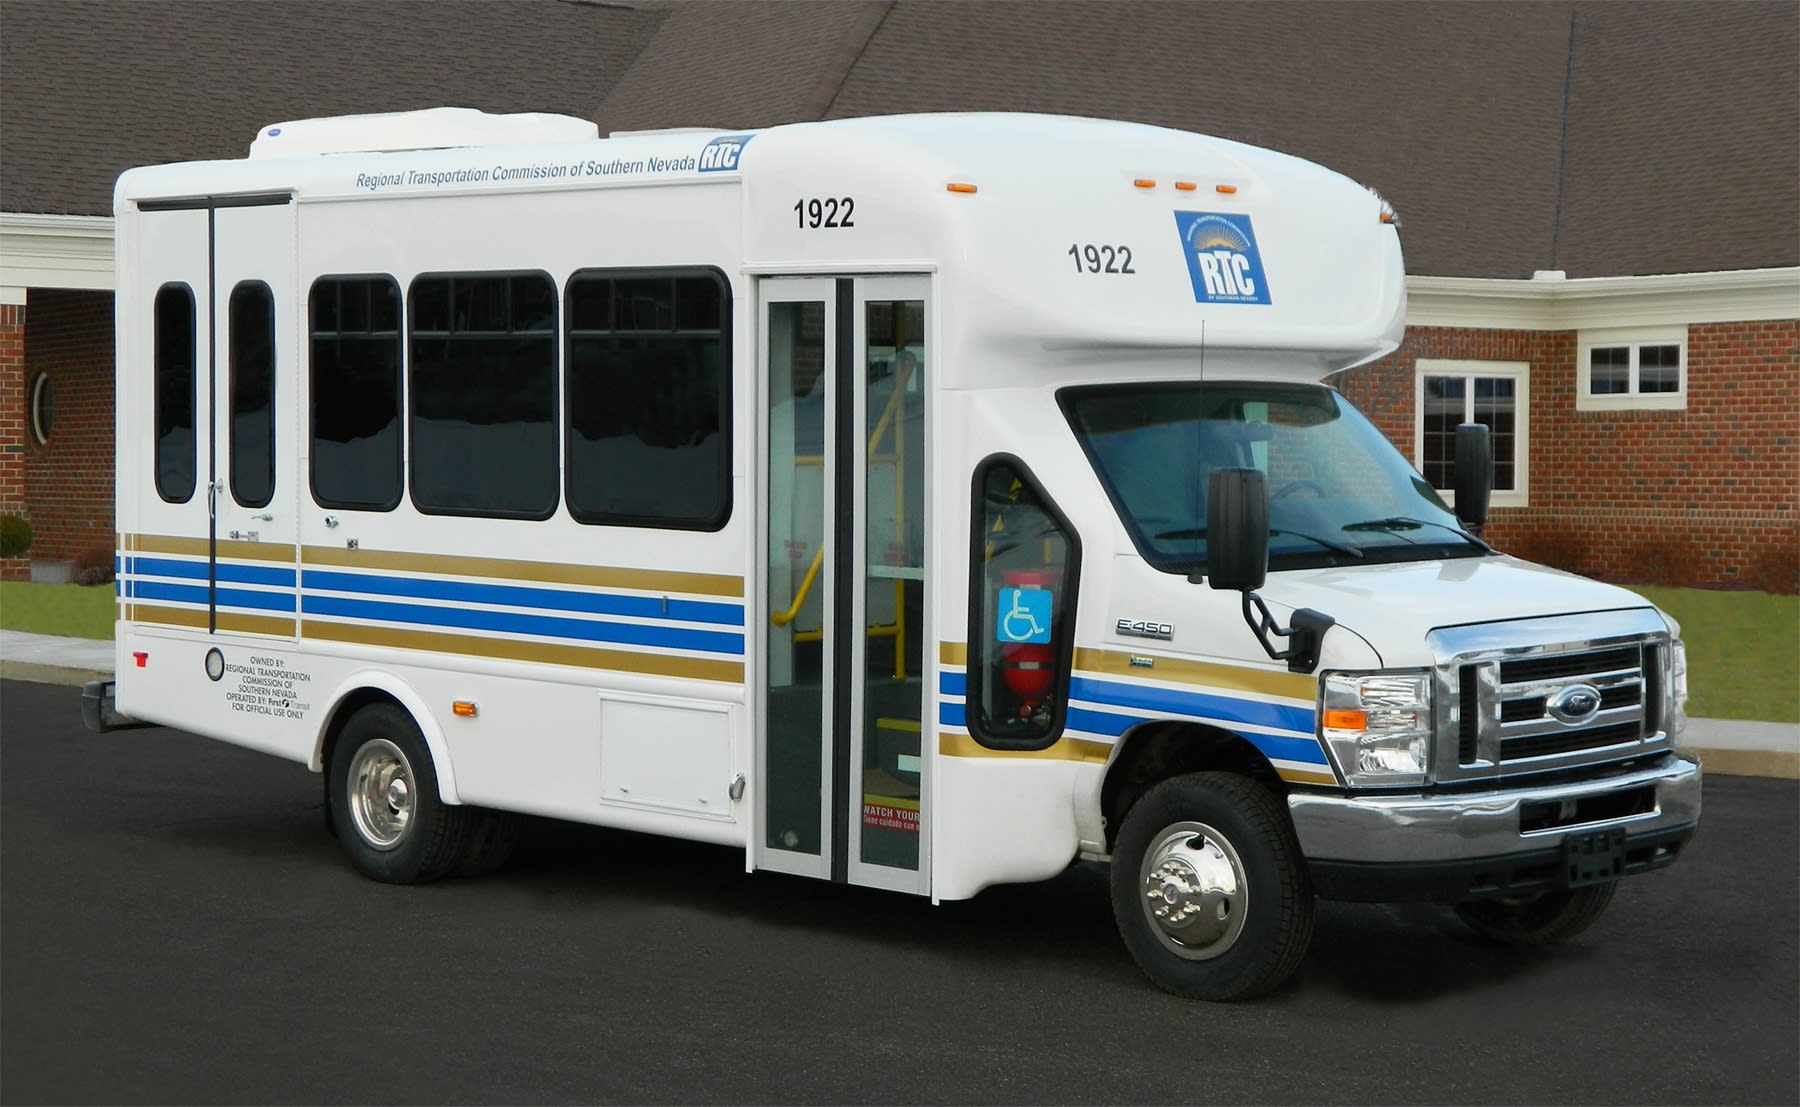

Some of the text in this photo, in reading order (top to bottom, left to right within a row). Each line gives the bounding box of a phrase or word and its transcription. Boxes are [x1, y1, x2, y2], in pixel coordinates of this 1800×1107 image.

[700, 143, 741, 169] RTC
[356, 155, 695, 191] Regional Transportation Commission of Southern Nevada
[794, 197, 854, 228] 1922
[1068, 243, 1136, 274] 1922
[1198, 250, 1255, 296] RTC
[250, 656, 285, 668] OWNED BY:
[226, 664, 311, 682] REGIONAL TRANSPORTATION
[242, 675, 293, 689] COMMISSION OF
[238, 684, 297, 699] SOUTHERN NEVADA
[226, 692, 310, 710] OPERATED BY: First Transit
[232, 702, 304, 719] FOR OFFICIAL USE ONLY
[864, 804, 920, 821] WATCH YOUR
